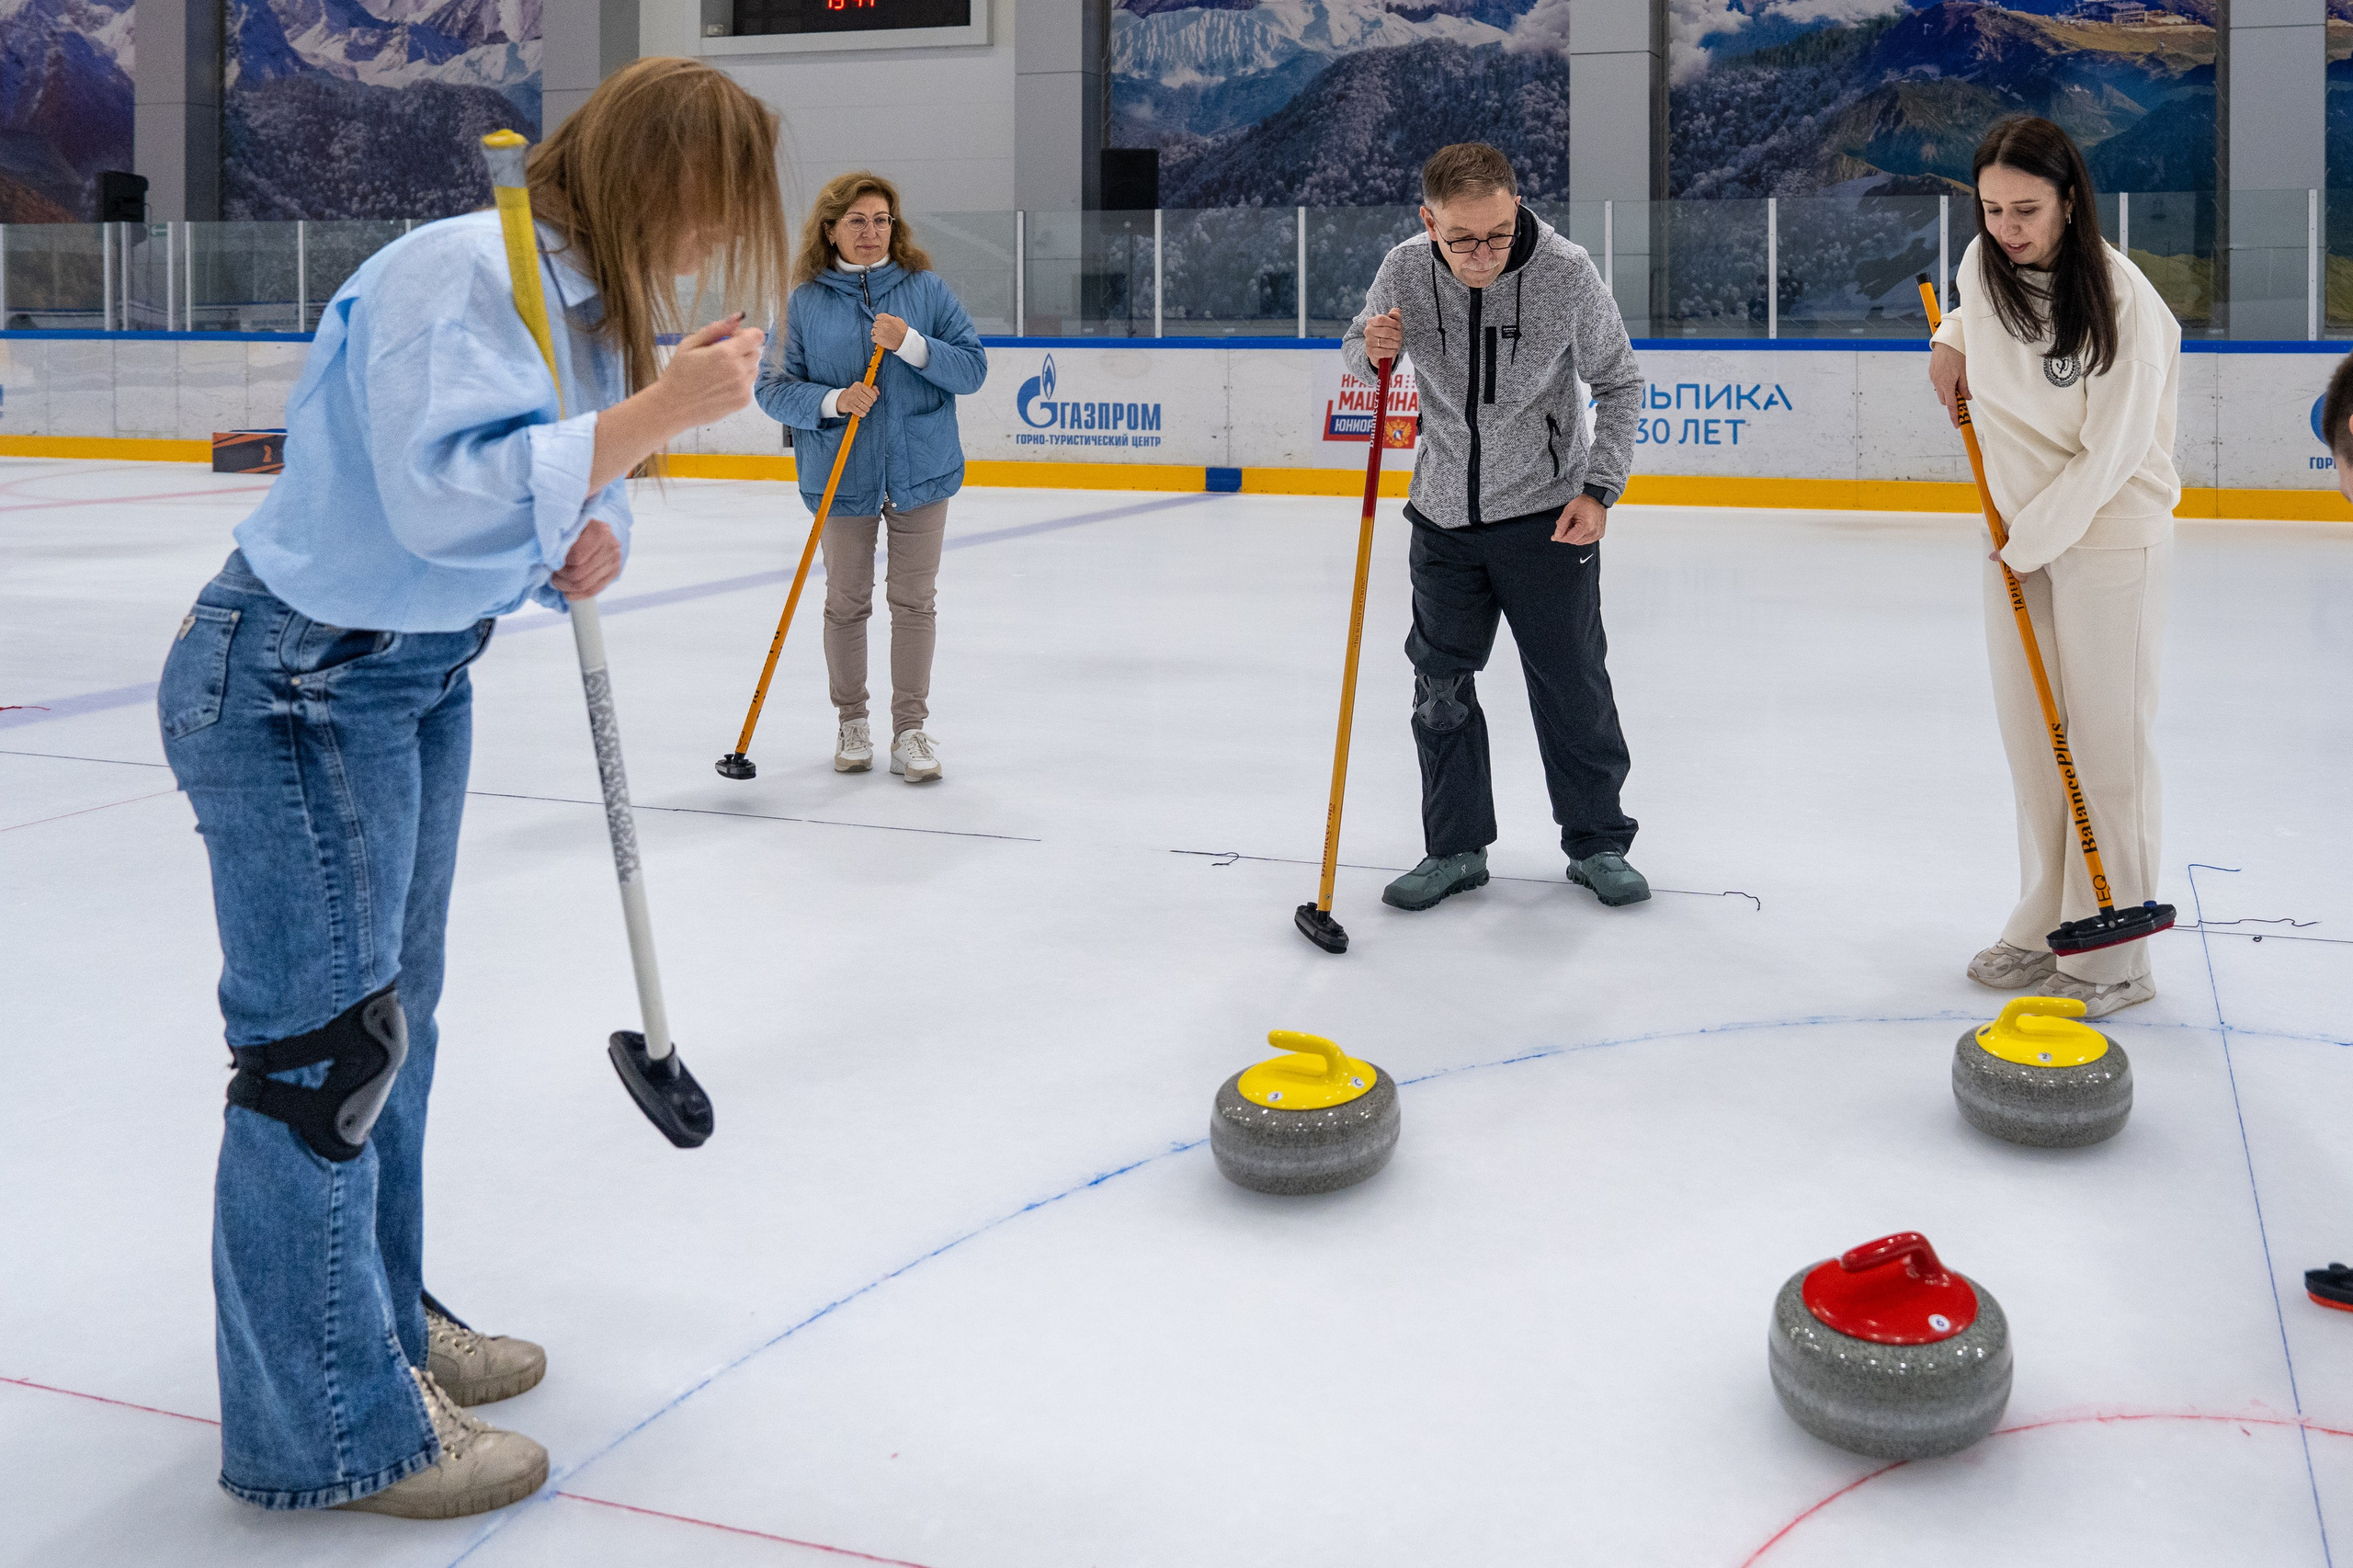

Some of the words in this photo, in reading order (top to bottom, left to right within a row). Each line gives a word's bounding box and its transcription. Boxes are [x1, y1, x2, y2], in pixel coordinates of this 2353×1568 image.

[1060, 402, 1162, 431] ГАЗПРОМ
[1016, 433, 1129, 447] ГОРНО-ТУРИСТИЧЕСКИЙ
[1131, 436, 1162, 448] ЦЕНТР
[1635, 417, 1670, 444] 30
[1678, 418, 1746, 445] ЛЕТ
[2052, 722, 2098, 855] BalancePlus
